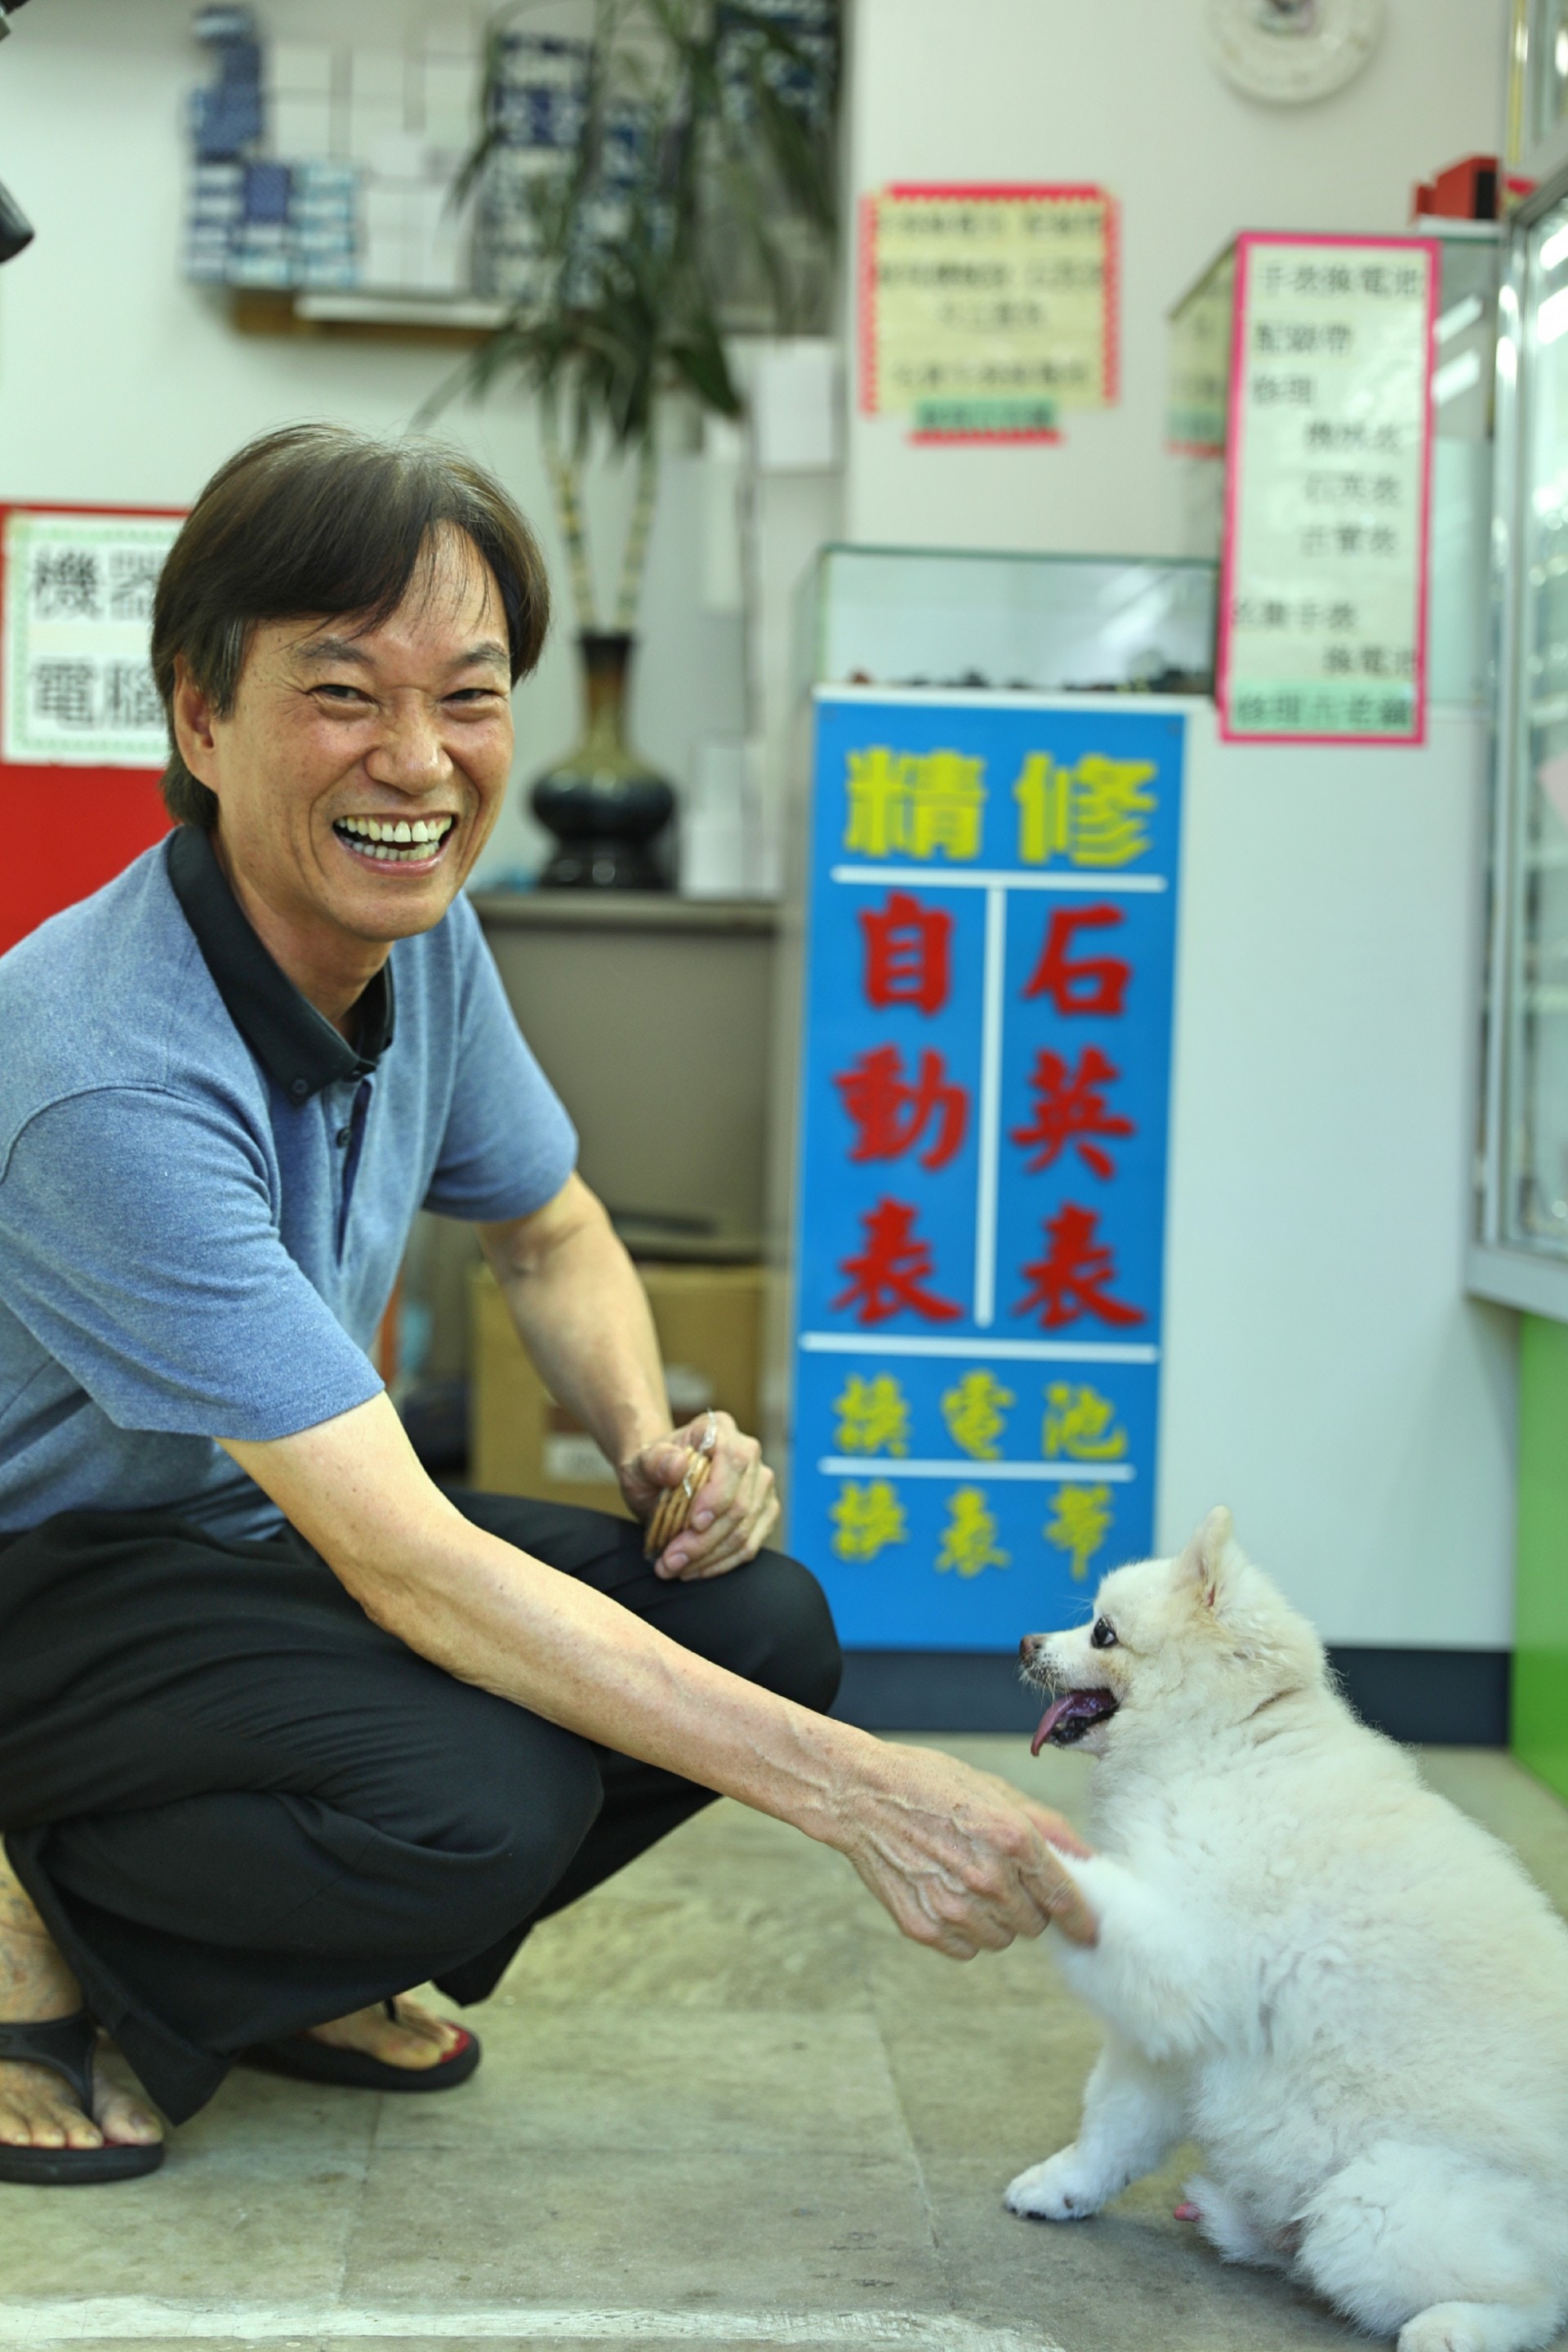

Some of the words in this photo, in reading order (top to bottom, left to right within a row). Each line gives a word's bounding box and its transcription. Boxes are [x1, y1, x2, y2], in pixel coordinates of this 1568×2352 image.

[844, 745, 1158, 867] 精修
[831, 887, 969, 1326] 自動表
[1009, 901, 1148, 1333] 石英表
